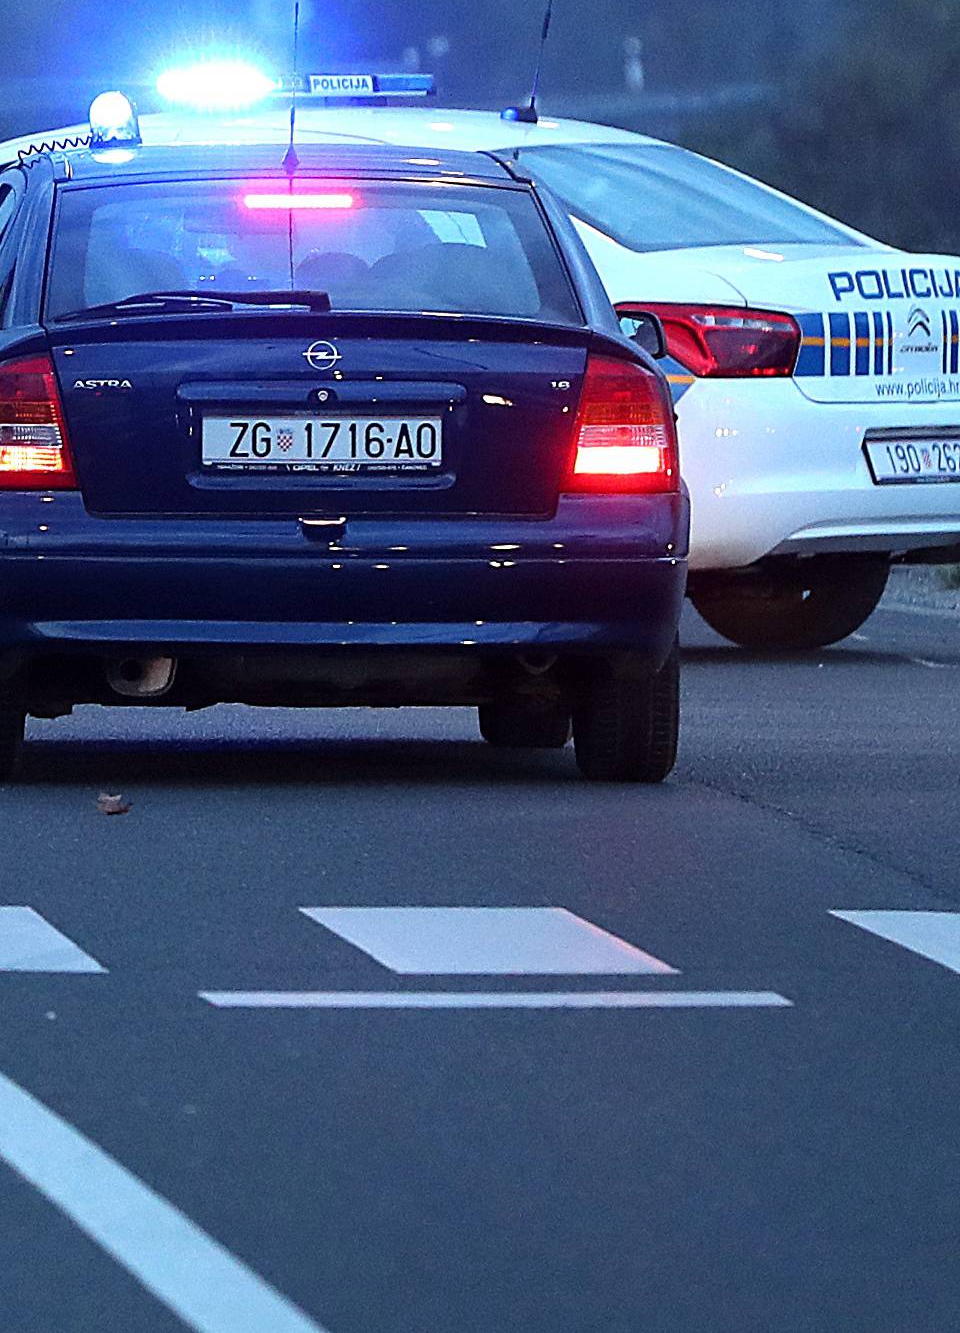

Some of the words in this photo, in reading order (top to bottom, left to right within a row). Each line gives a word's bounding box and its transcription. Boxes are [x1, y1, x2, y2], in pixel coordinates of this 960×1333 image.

[313, 78, 370, 91] POLICIJA
[828, 268, 960, 301] POLICIJ
[73, 379, 132, 390] ASTRA
[875, 377, 960, 399] www.policija.hr
[229, 421, 271, 458] ZG
[304, 421, 437, 459] 1716-AO
[886, 443, 921, 474] 190
